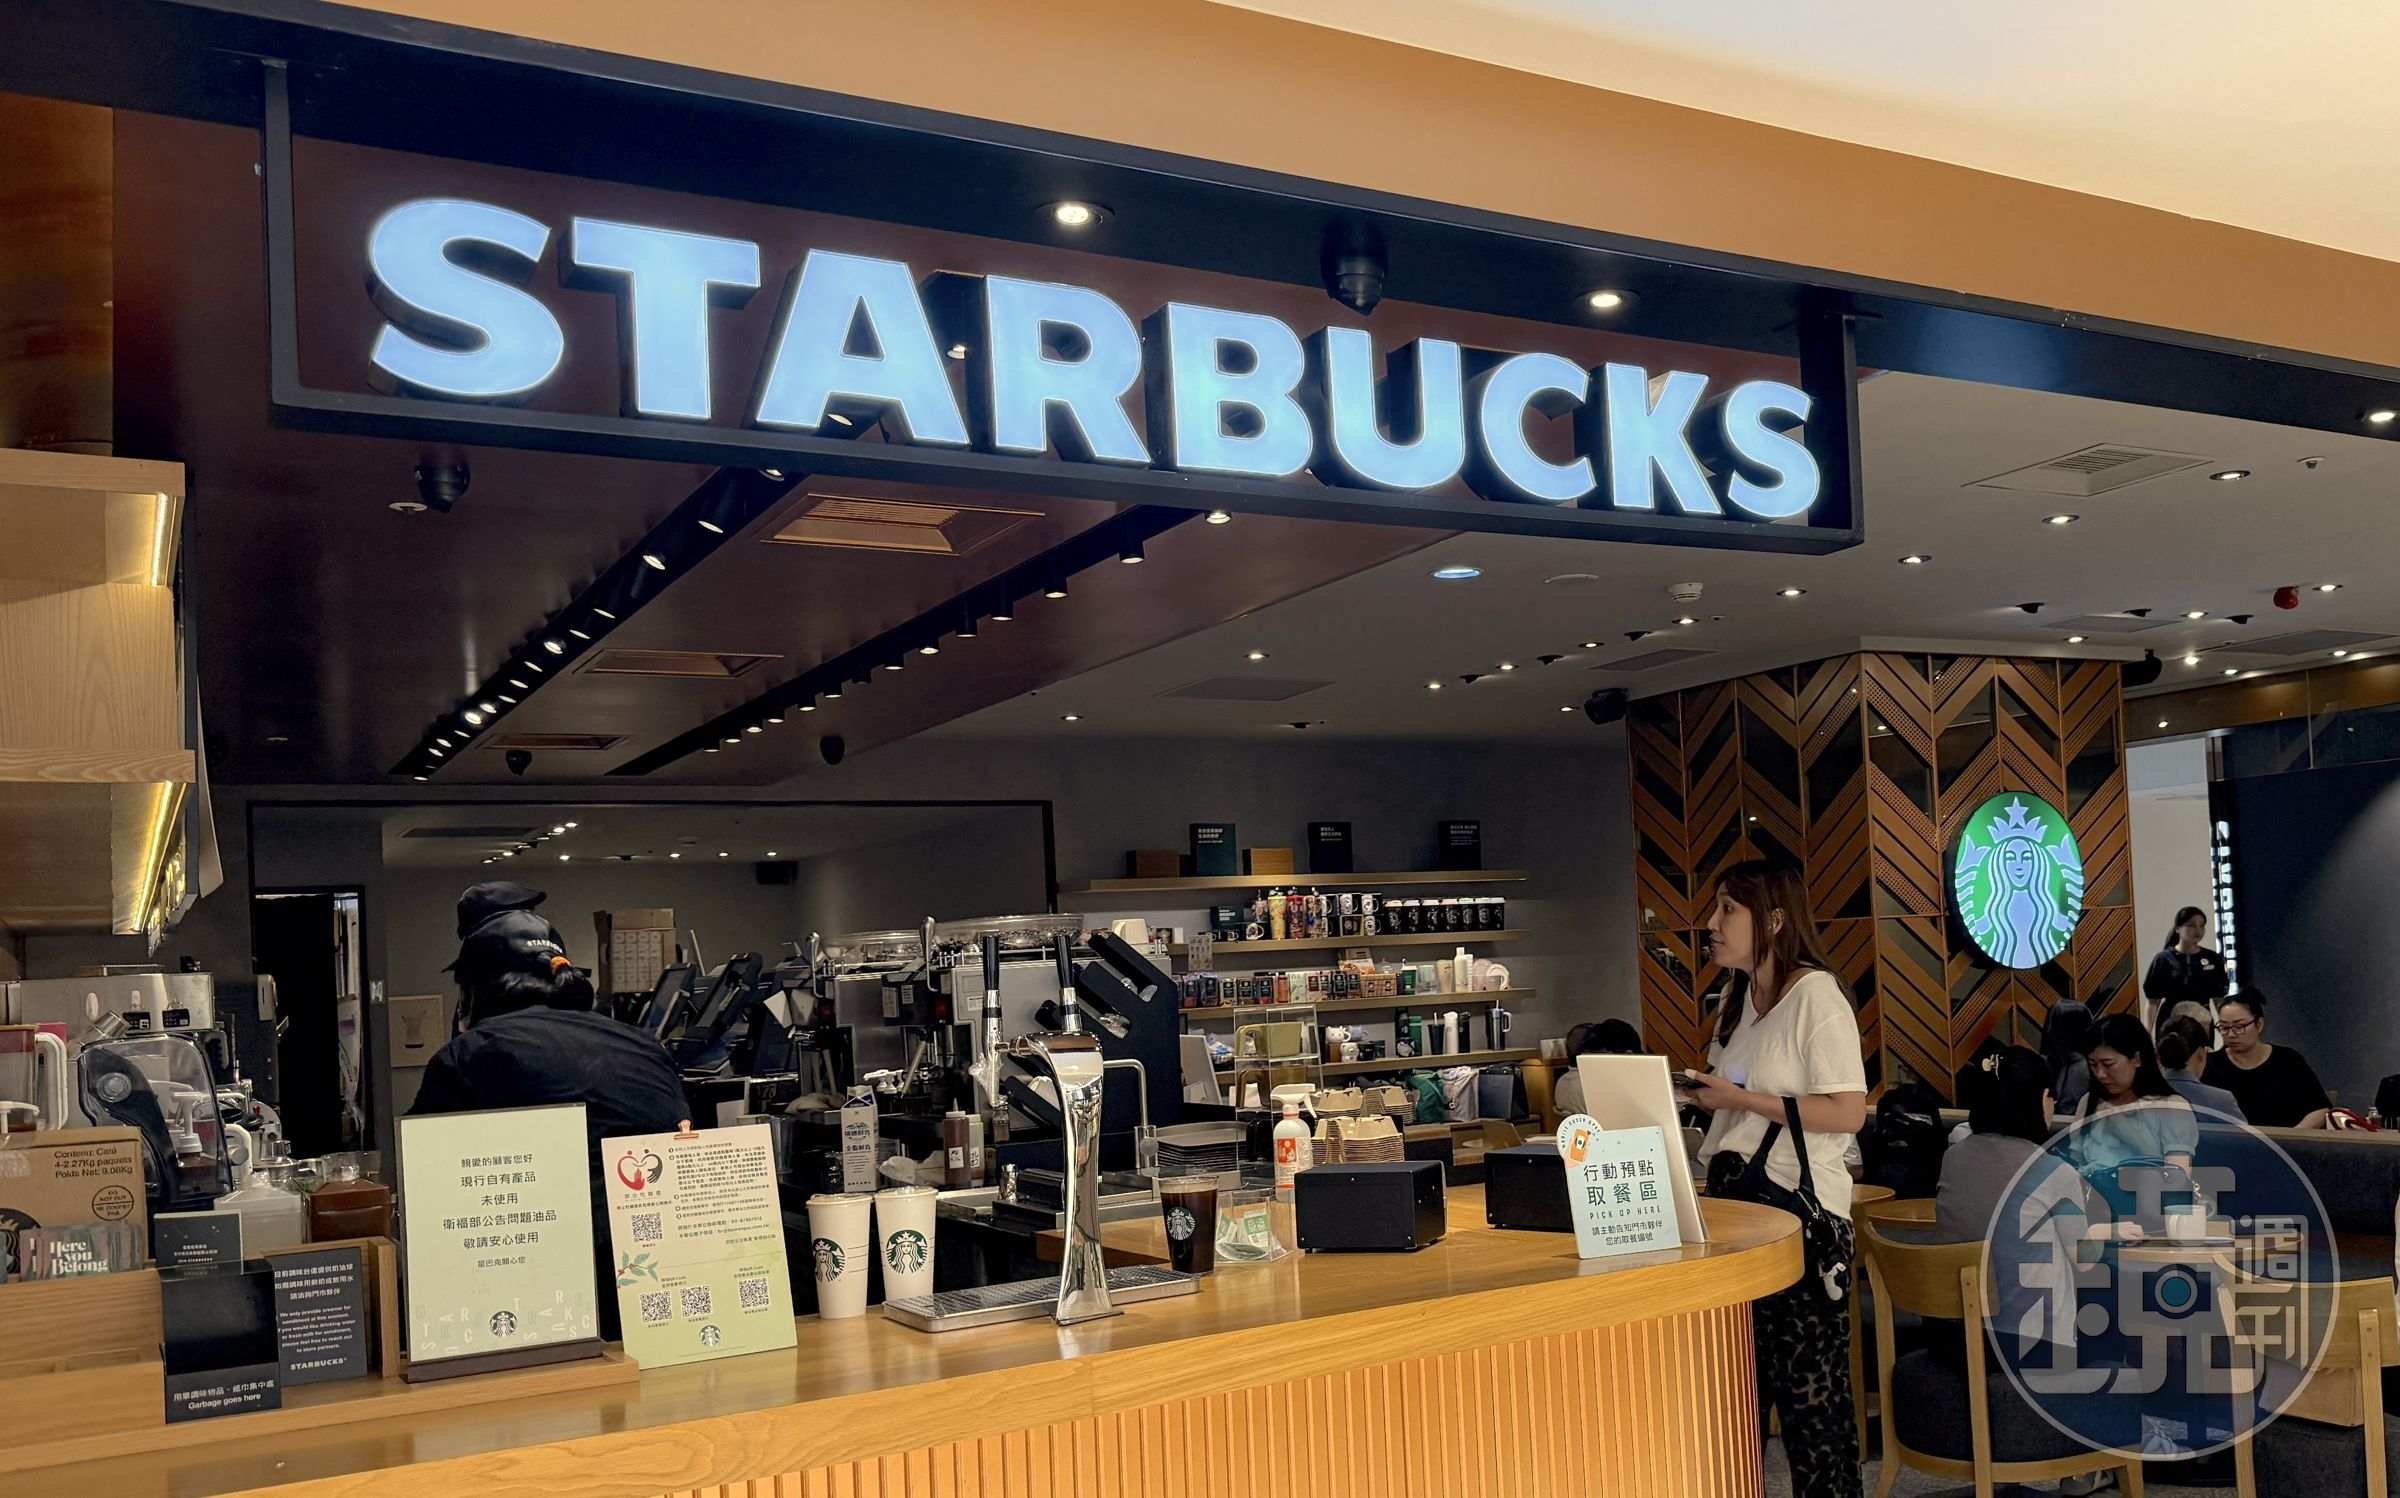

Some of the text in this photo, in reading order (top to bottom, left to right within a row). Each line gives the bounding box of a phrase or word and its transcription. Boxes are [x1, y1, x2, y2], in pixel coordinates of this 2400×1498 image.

[364, 196, 1822, 522] STARBUCKS
[54, 1157, 132, 1168] 4-2.27Kg paquets
[461, 1153, 534, 1168] 親愛的顧客您好
[55, 1169, 80, 1178] Poids
[1584, 1160, 1655, 1182] 行動預點
[460, 1171, 536, 1188] 現行自有產品
[481, 1193, 519, 1206] 未使用
[1586, 1181, 1658, 1206] 取餐區
[443, 1209, 557, 1230] 衛福部公告問題油品
[1590, 1210, 1613, 1220] PICK
[1637, 1205, 1661, 1216] HERE
[1592, 1220, 1663, 1236] 請主動告知門市夥伴
[463, 1231, 539, 1250] 敬請安心使用
[1605, 1232, 1654, 1246] 您的取餐編號
[50, 1241, 87, 1257] Here
[63, 1250, 93, 1263] you
[51, 1258, 109, 1275] Belong
[477, 1256, 526, 1268] 星巴克關心您
[301, 1308, 321, 1317] provide
[319, 1320, 341, 1329] drinking
[188, 1392, 261, 1410] Garbage goes here
